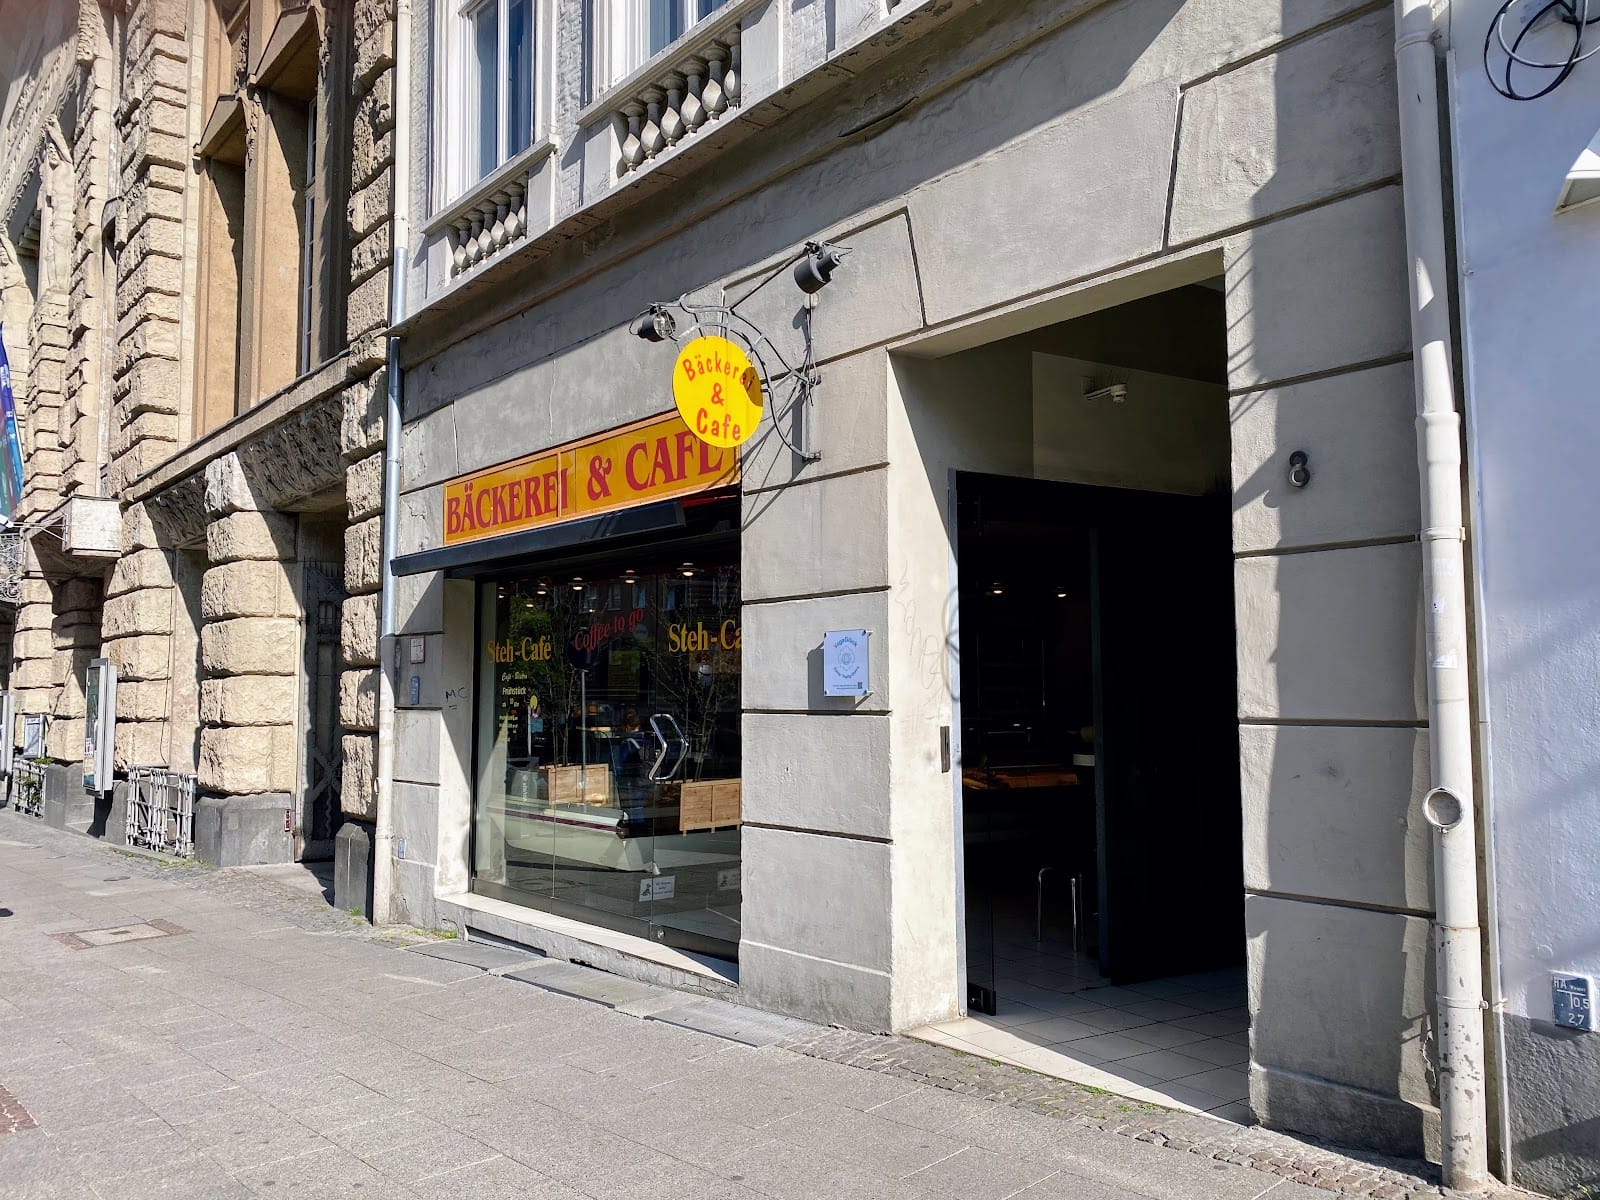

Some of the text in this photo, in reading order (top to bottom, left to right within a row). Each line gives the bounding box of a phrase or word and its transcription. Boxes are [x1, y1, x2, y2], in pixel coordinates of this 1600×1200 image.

[682, 350, 756, 392] Bäckerei
[711, 382, 724, 406] &
[696, 407, 742, 441] Cafe
[1289, 450, 1310, 487] 8
[447, 468, 568, 535] BÄCKEREI
[587, 455, 612, 501] &
[574, 607, 644, 652] Coffee to go
[487, 634, 551, 664] Steh-Café
